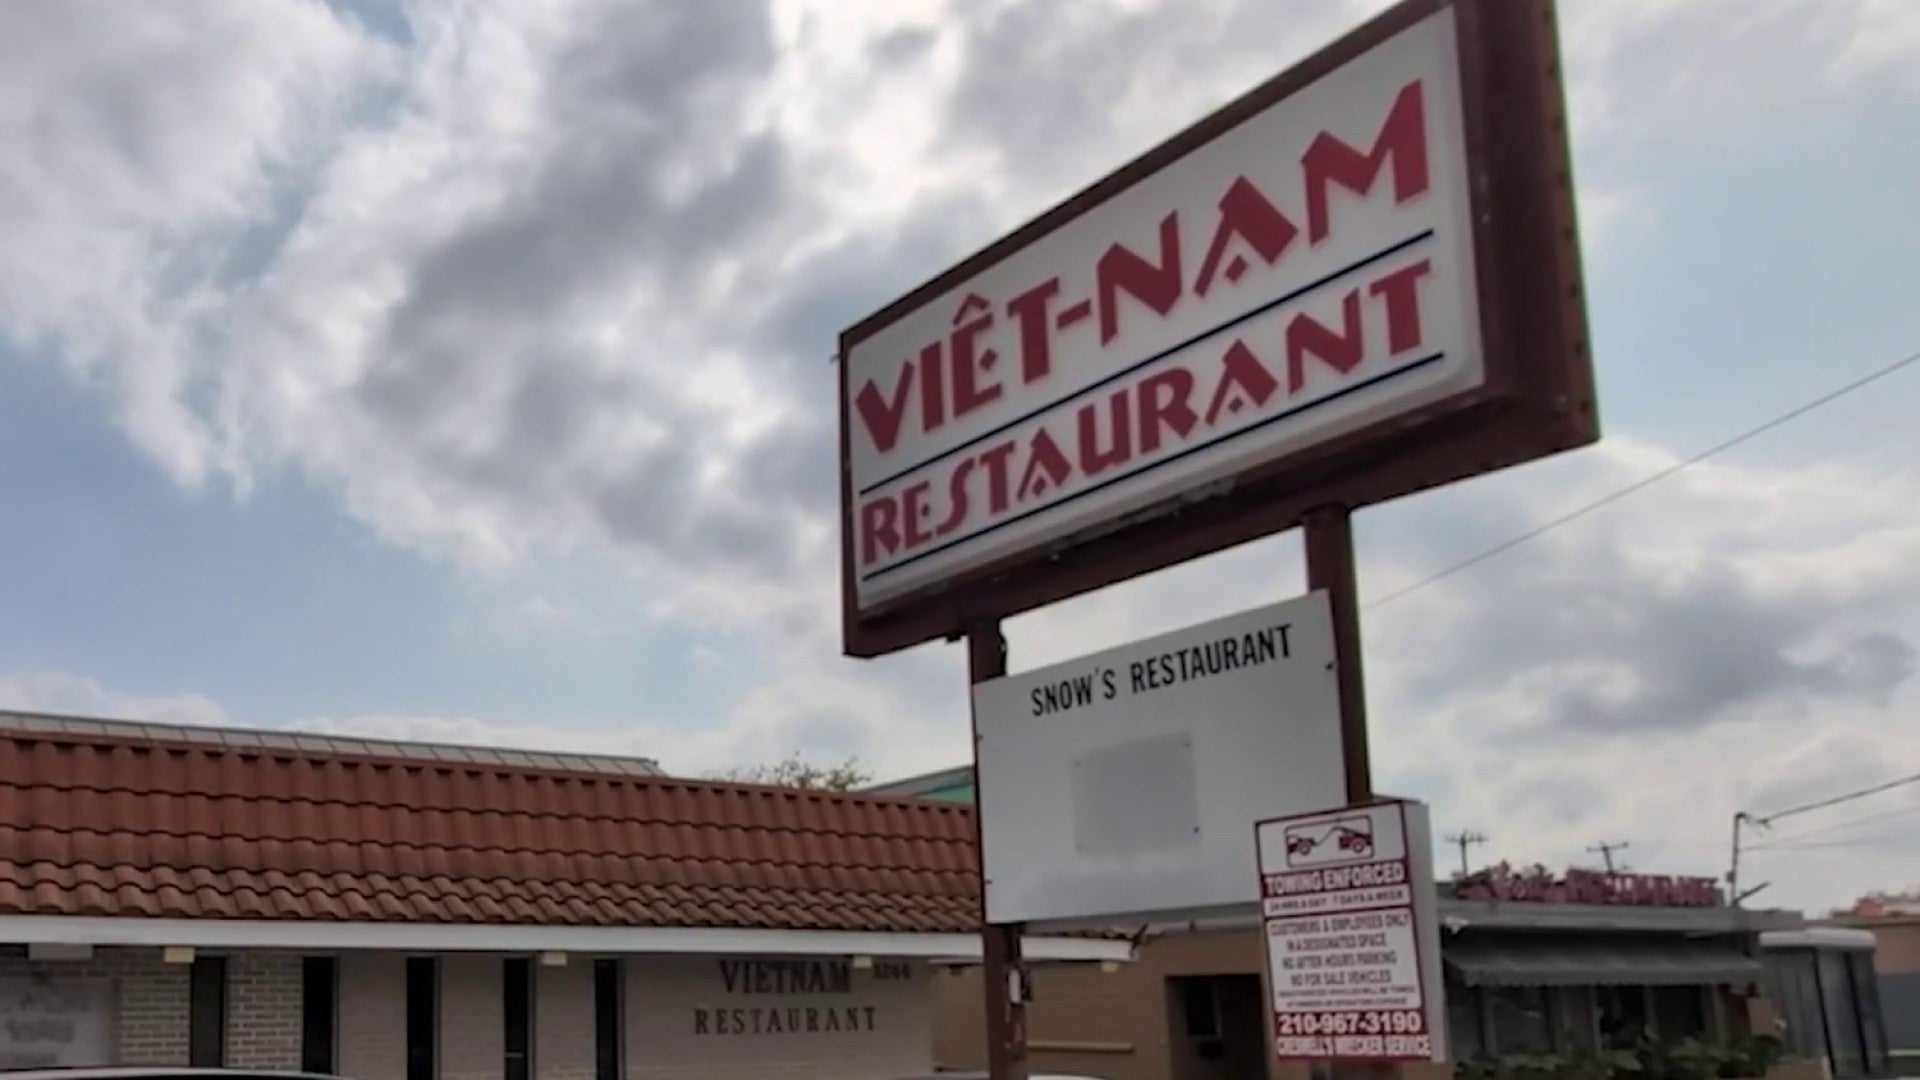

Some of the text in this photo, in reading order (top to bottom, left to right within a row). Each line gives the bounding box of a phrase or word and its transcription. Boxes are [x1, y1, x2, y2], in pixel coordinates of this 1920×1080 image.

[860, 259, 1431, 564] RESTAURANT
[1031, 624, 1292, 716] SNOW'S RESTAURANT
[1265, 863, 1404, 895] TOWING ENFORCED
[1271, 921, 1321, 936] CUSTOMERS
[1332, 915, 1383, 931] EMPLOYEES
[1385, 913, 1409, 927] ONLY
[1303, 935, 1356, 951] DESIGNATED
[1359, 933, 1385, 947] SPACE
[1282, 950, 1397, 969] NO AFTER HOURS PARKING
[719, 960, 852, 993] VIETNAM
[1291, 969, 1391, 986] NO FOR SALE VEHICLES
[694, 1007, 876, 1034] RESTAURANT
[1278, 1012, 1422, 1034] 210-967-3190
